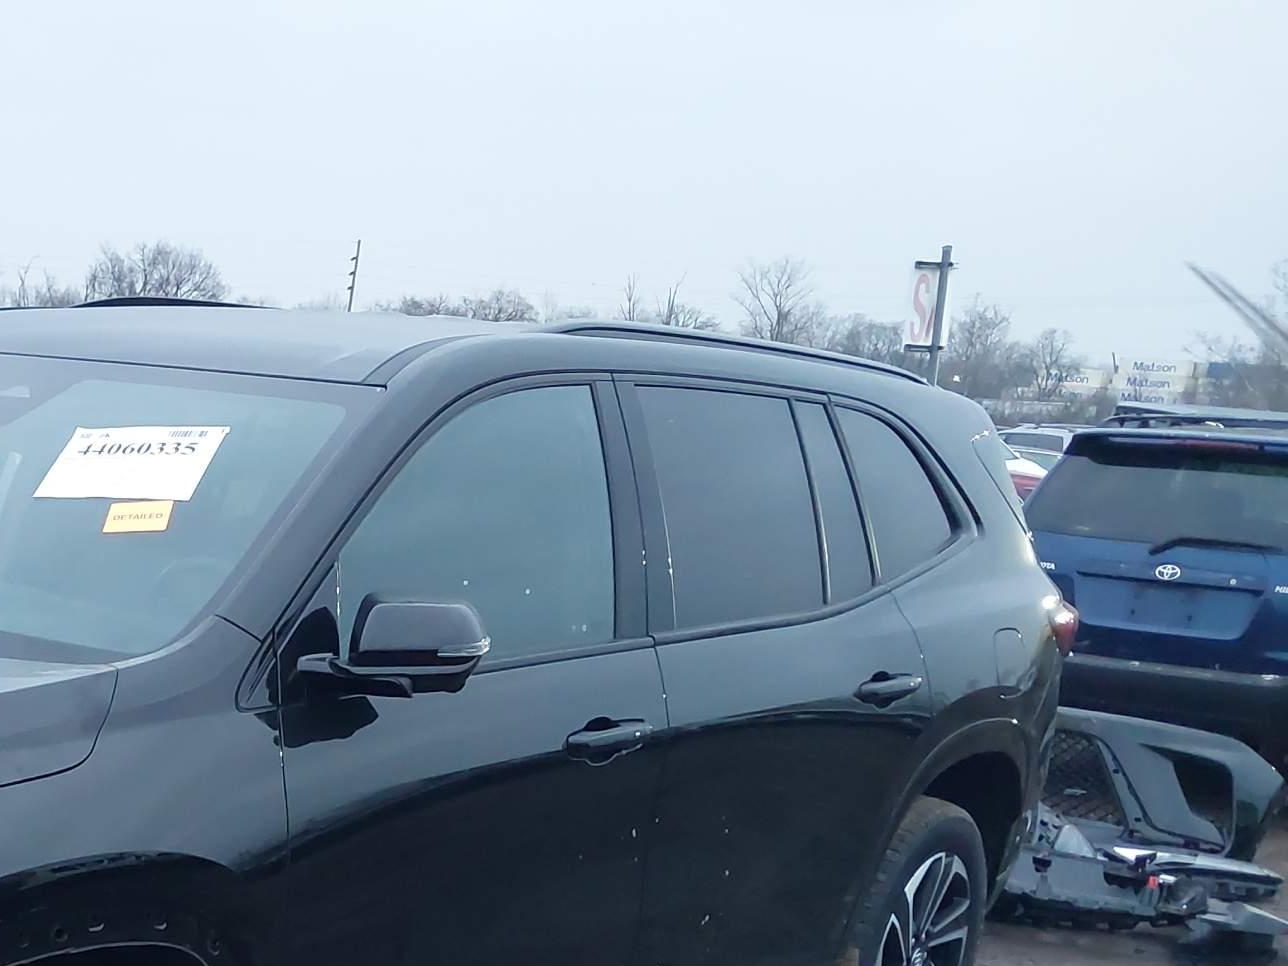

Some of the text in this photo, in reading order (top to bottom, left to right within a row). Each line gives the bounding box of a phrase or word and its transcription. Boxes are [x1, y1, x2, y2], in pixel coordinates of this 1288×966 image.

[910, 272, 935, 343] S
[1132, 361, 1177, 373] Matson
[1125, 376, 1171, 389] Matson
[77, 442, 200, 456] 44060335
[112, 512, 164, 521] DETAILED
[1040, 561, 1056, 570] OTA
